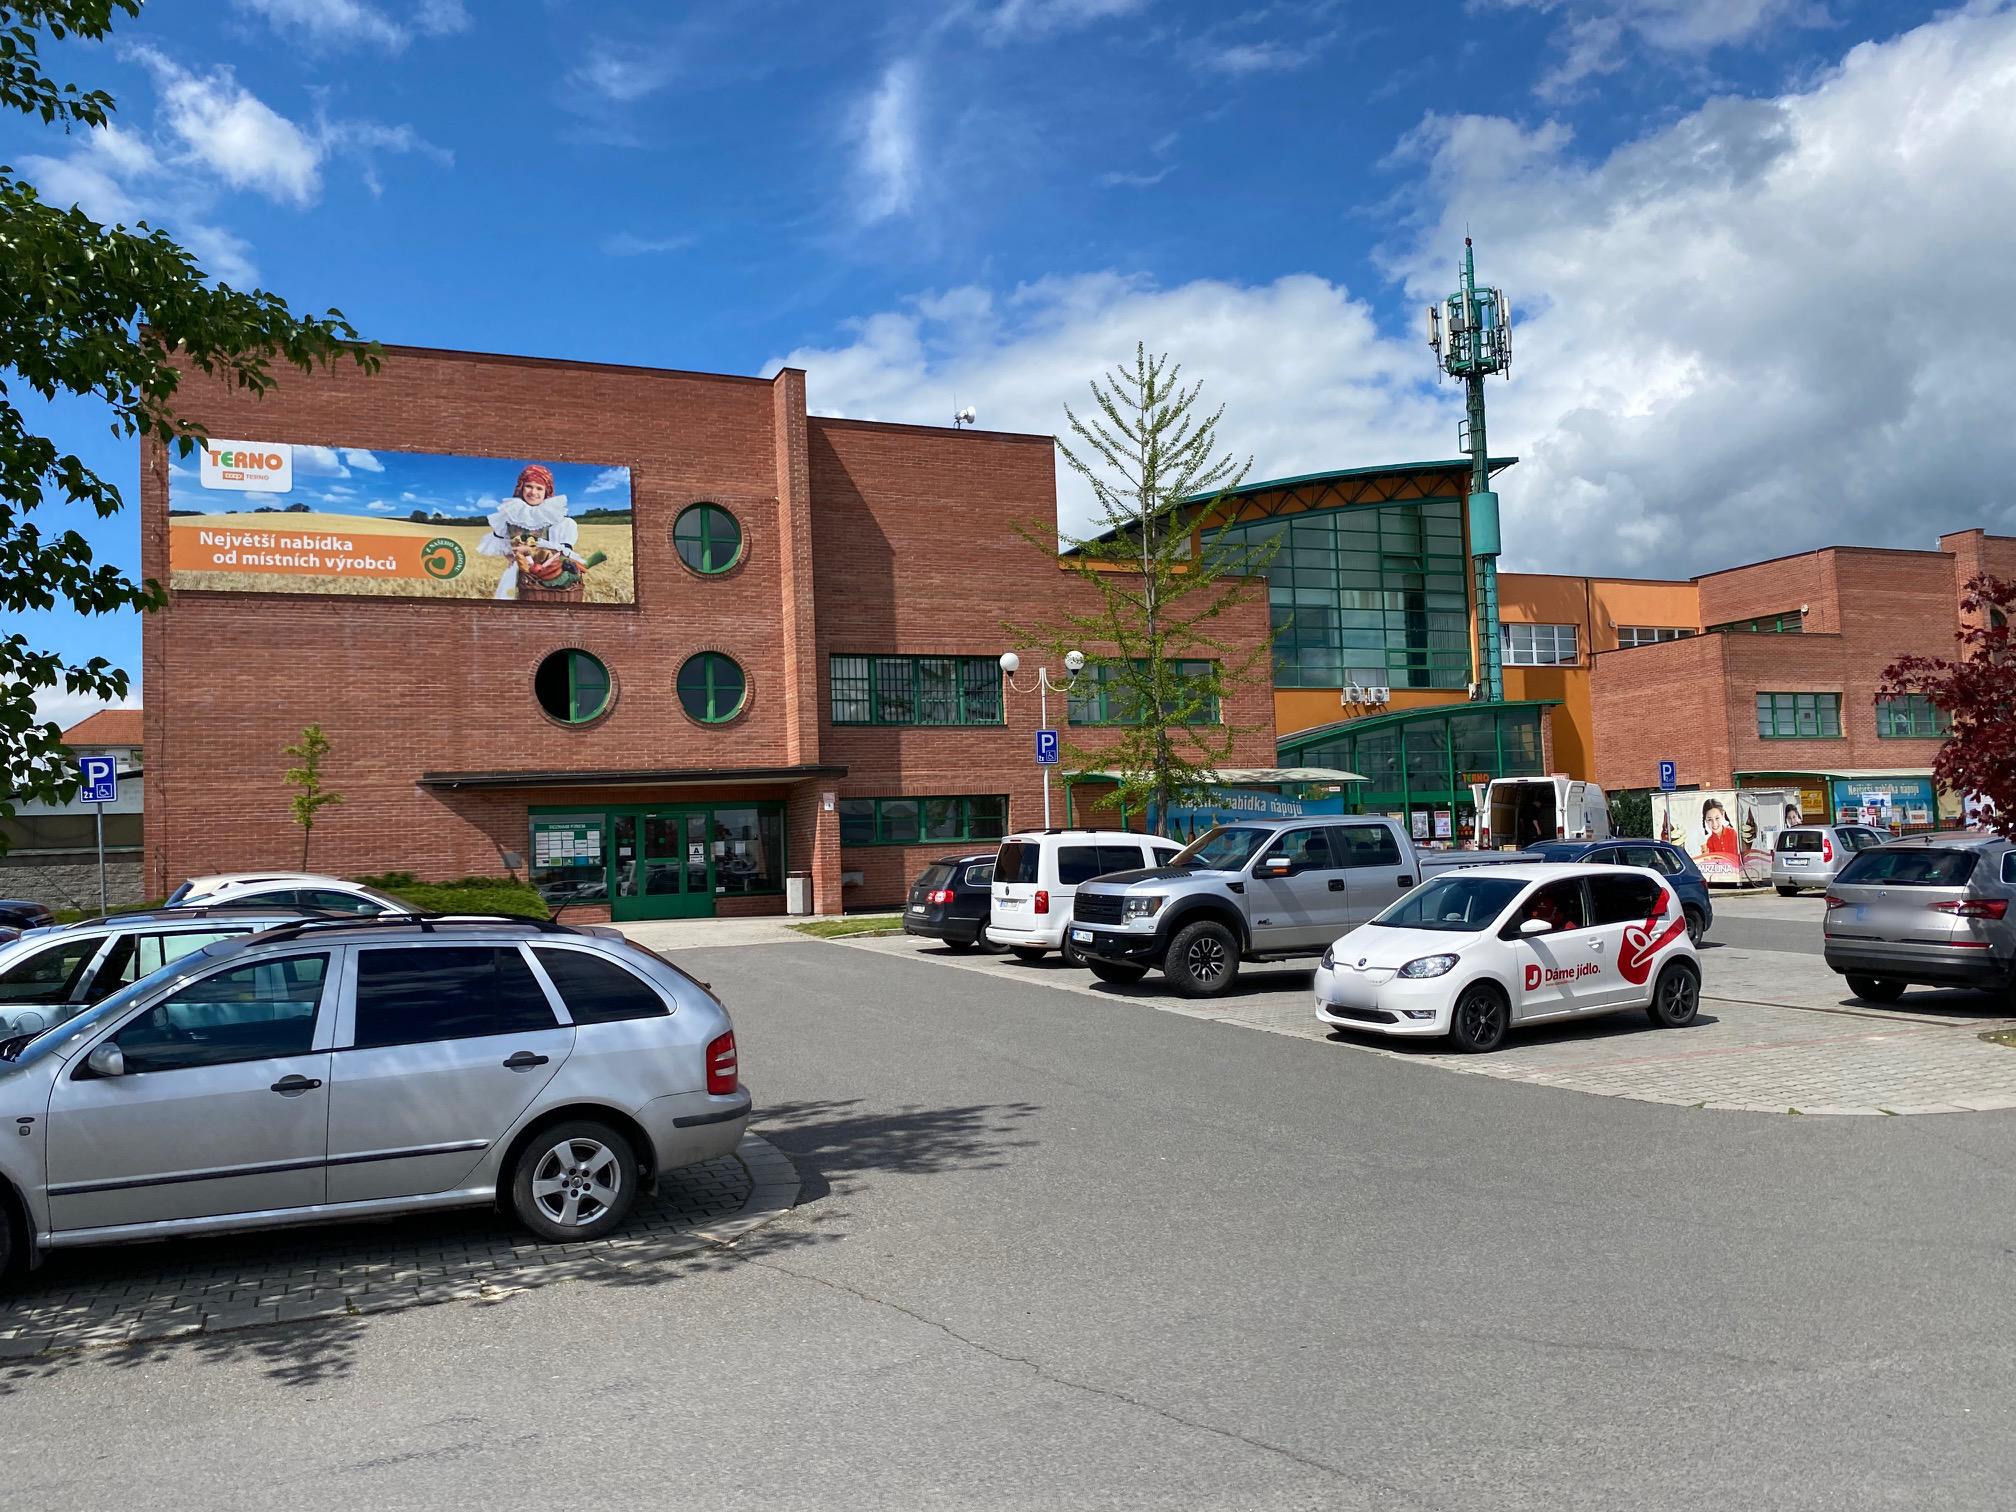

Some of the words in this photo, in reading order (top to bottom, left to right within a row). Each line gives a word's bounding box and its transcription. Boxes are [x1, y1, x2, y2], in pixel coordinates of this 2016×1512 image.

[209, 450, 283, 471] TERNO
[200, 531, 276, 549] Největší
[280, 535, 353, 551] nabídka
[213, 551, 236, 564] od
[242, 552, 320, 568] místních
[325, 555, 397, 572] výrobců
[1041, 734, 1055, 753] P
[88, 762, 109, 787] P
[1462, 773, 1489, 783] TERNO
[1662, 764, 1672, 781] P
[83, 790, 94, 799] 2x
[1180, 790, 1222, 811] ejširší
[1225, 795, 1267, 812] nabídka
[1698, 863, 1733, 873] MRZLINA
[1545, 967, 1575, 982] Dáme
